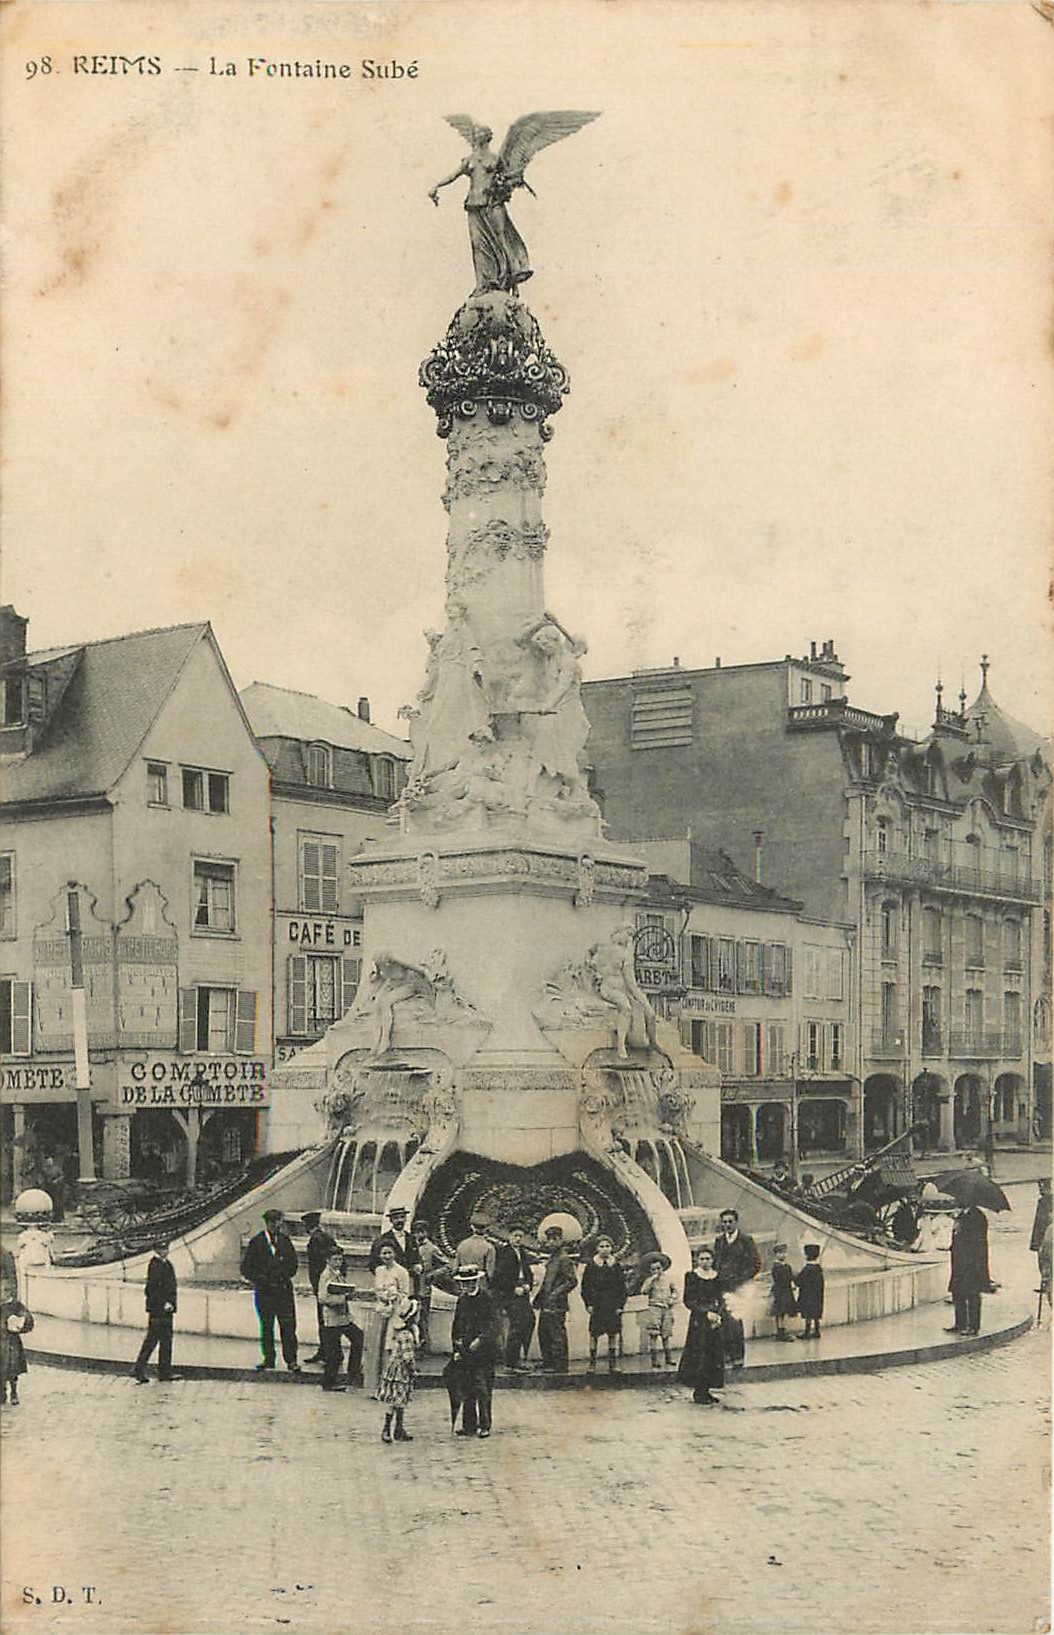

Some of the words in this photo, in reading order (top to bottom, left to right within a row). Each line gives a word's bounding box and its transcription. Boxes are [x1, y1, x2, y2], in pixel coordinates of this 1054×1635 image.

[289, 920, 335, 945] CAFÉ
[344, 930, 361, 946] DE
[0, 1064, 64, 1090] MÈTE
[131, 1062, 266, 1081] COMPTOIR
[122, 1086, 147, 1104] DE
[150, 1085, 176, 1103] LA
